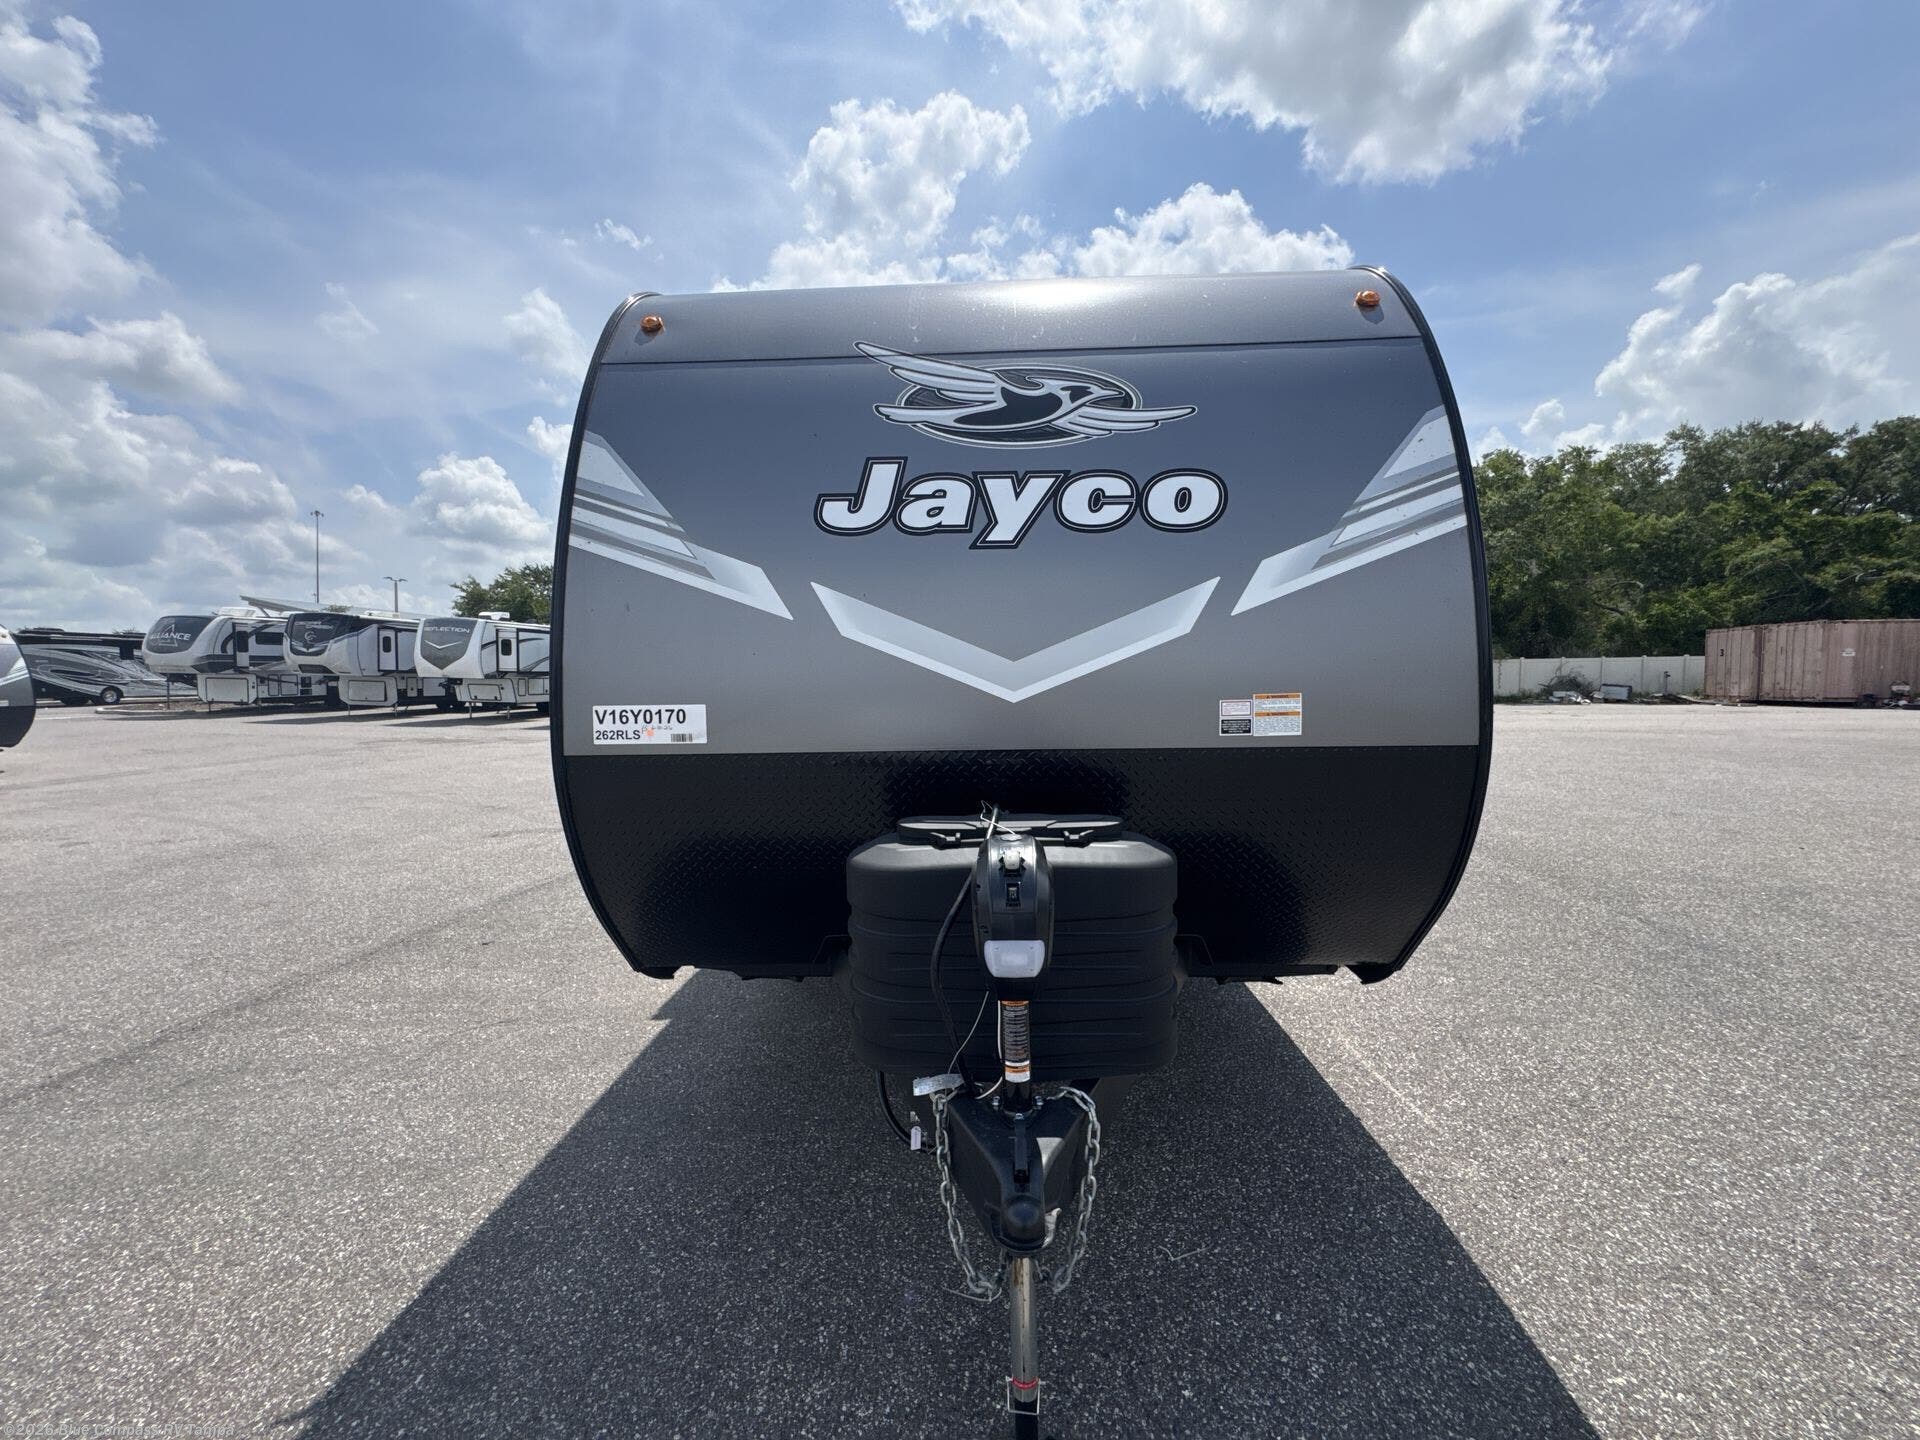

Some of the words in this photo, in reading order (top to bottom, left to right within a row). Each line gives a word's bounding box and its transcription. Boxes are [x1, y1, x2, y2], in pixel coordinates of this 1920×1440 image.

[814, 456, 1228, 550] Jayco
[595, 709, 686, 724] V16Y0170
[595, 730, 641, 740] 262RLS
